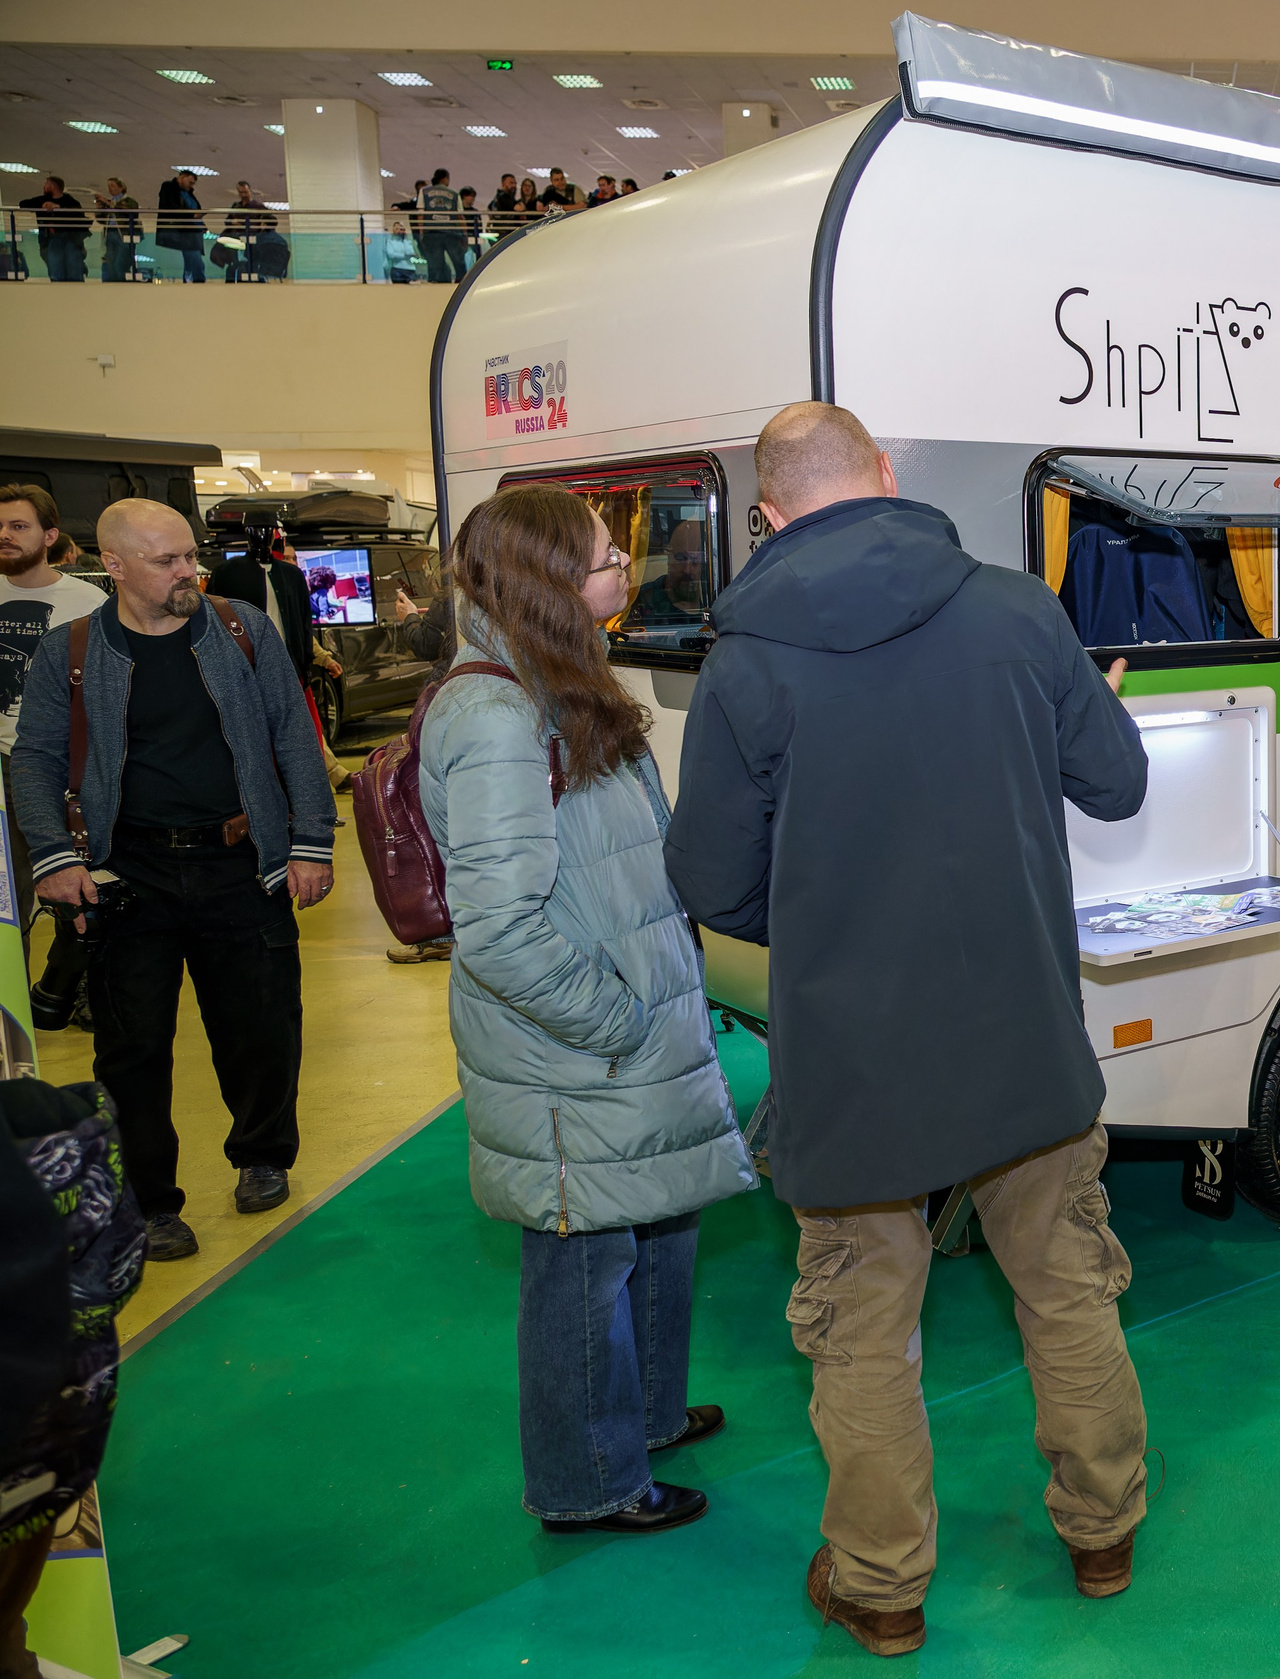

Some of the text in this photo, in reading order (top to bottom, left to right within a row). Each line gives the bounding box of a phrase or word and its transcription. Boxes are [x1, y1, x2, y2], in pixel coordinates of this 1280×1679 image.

[544, 360, 567, 395] 20
[515, 396, 568, 434] RUSSIA 24
[16, 628, 44, 636] time?
[1194, 1181, 1222, 1198] PETSUN
